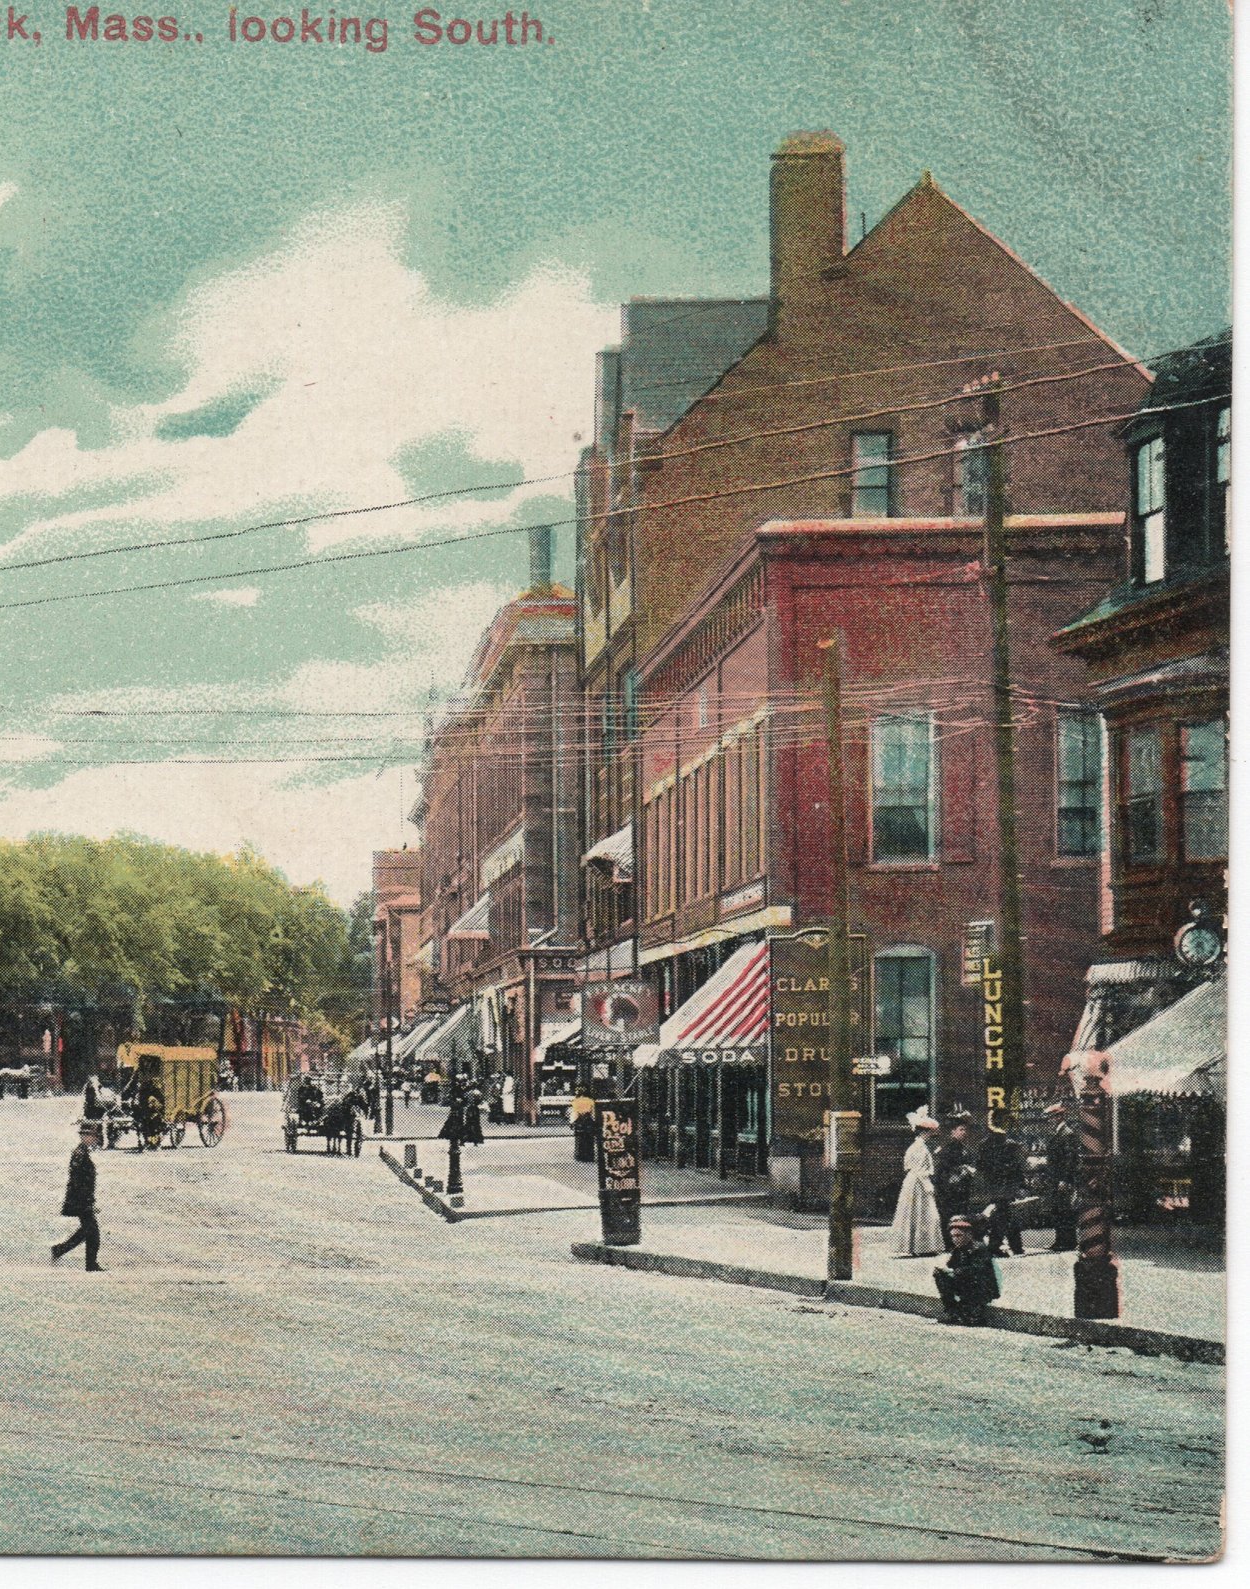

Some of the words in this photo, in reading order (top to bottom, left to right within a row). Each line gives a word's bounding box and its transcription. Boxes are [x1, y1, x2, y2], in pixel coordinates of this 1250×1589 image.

[776, 977, 858, 992] CLARS
[775, 1012, 859, 1027] POPULR
[982, 957, 1004, 1070] LUNCH
[681, 1049, 756, 1064] SODA
[784, 1047, 832, 1062] DRU
[601, 1110, 633, 1138] Pool
